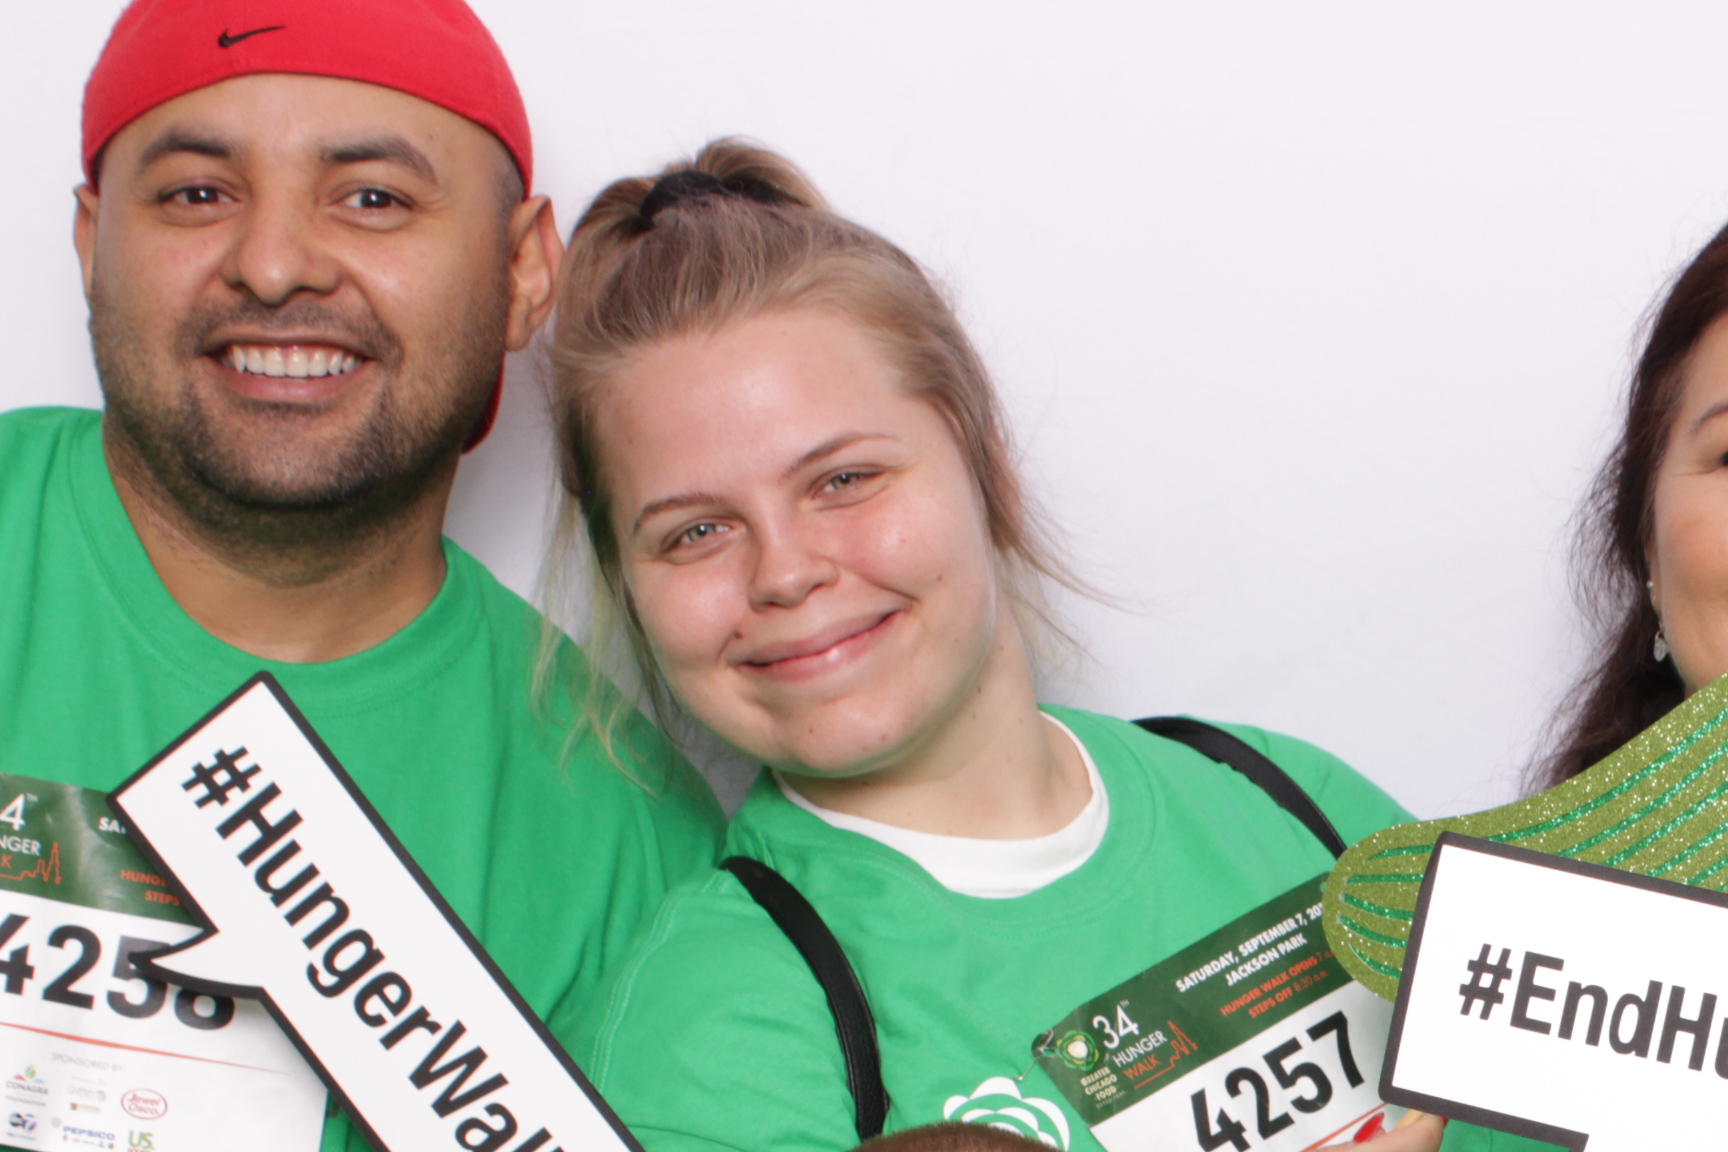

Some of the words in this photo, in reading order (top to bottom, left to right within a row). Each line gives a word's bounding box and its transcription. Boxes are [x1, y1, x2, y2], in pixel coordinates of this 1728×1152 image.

[0, 793, 26, 831] 4
[0, 835, 41, 856] NGER
[120, 869, 168, 887] HUNG
[1175, 950, 1240, 993] SATURDAY,
[1238, 917, 1298, 958] SEPTEMBER
[1295, 912, 1308, 926] 7,
[1306, 901, 1323, 920] 20
[1224, 946, 1280, 987] JACKSON
[1277, 932, 1308, 957] PARK
[1220, 986, 1264, 1017] HUNGER
[1259, 971, 1290, 993] WALK
[1288, 955, 1319, 977] OPENS
[1248, 996, 1277, 1019] STEPS
[1275, 986, 1294, 1003] OFF
[1112, 1030, 1168, 1068] HUNGER
[1080, 1066, 1111, 1087] GREATER
[1122, 1053, 1162, 1080] WALK
[1084, 1073, 1118, 1096] CHICAGO
[1095, 1085, 1117, 1101] FOOD
